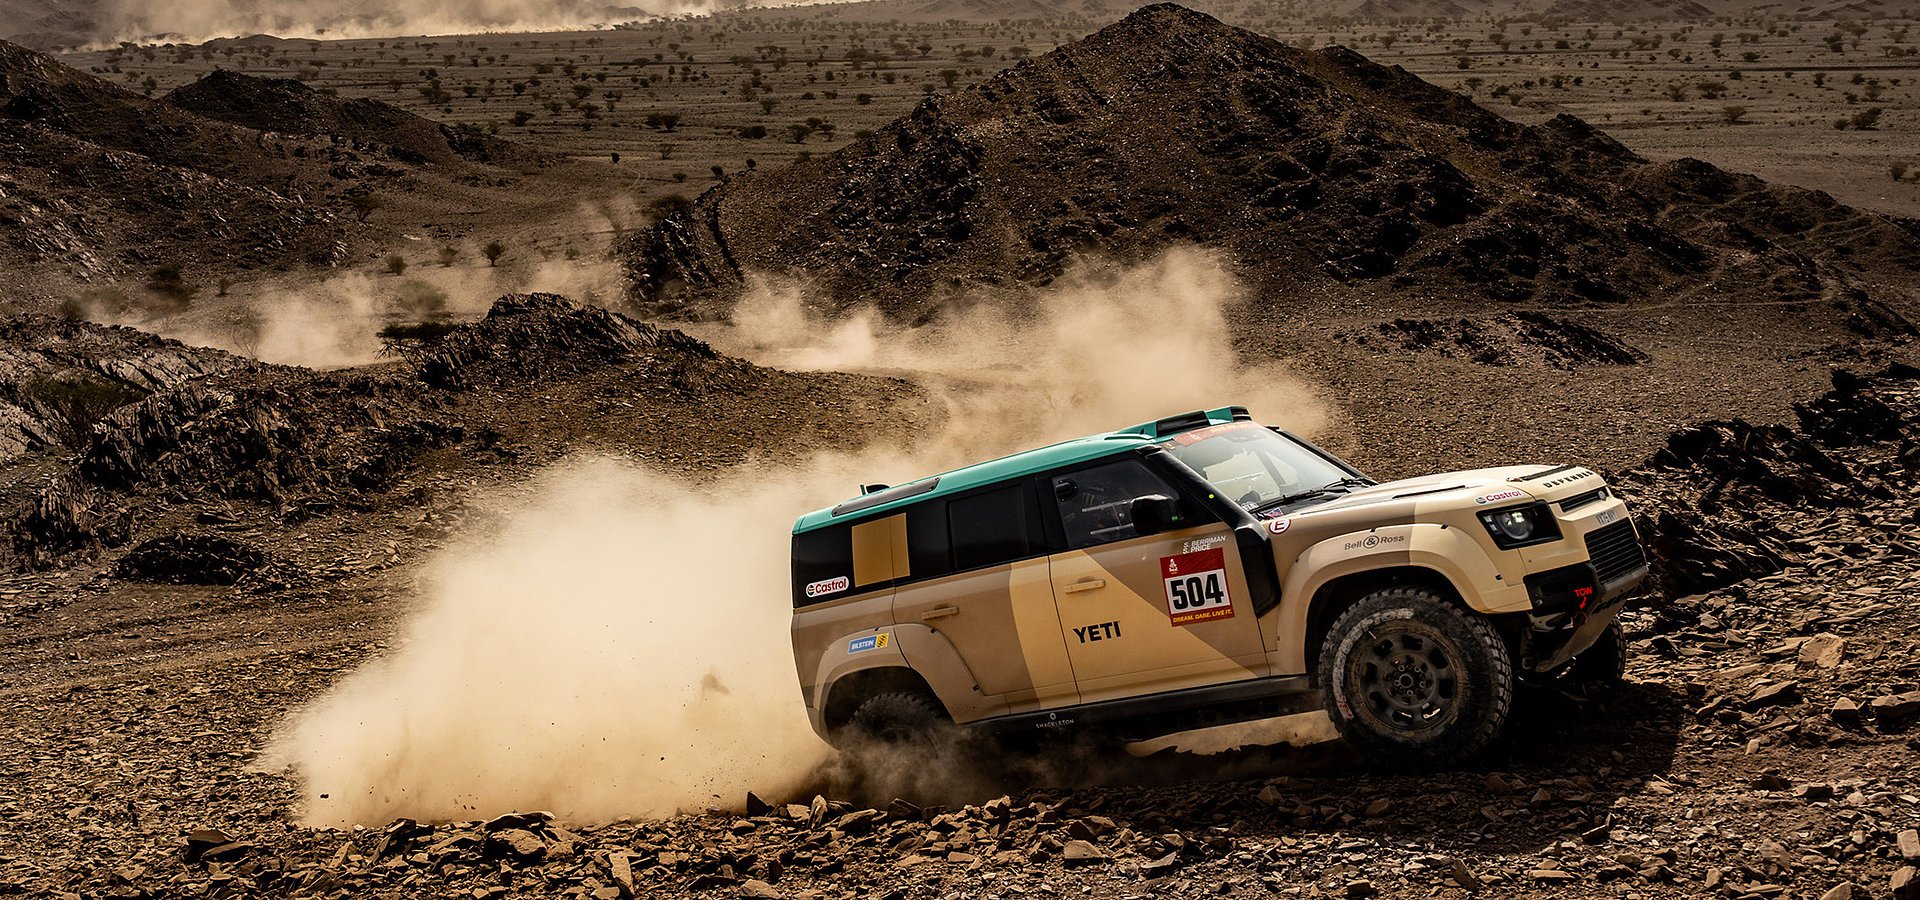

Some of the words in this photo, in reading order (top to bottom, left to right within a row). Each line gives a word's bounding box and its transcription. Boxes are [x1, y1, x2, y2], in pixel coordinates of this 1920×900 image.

[1485, 490, 1521, 501] Castrol
[1275, 521, 1285, 530] E
[1191, 535, 1226, 547] BERRIMAN
[1344, 541, 1362, 550] Bell
[1380, 535, 1405, 544] Ross
[1190, 543, 1212, 553] PRICE
[815, 578, 846, 593] Castrol
[1170, 573, 1224, 610] 504
[1573, 586, 1593, 597] TOW
[1173, 615, 1194, 623] DREAM.
[1195, 612, 1211, 620] DARE.
[1212, 609, 1224, 617] LIVE
[1072, 621, 1122, 644] YETI
[851, 640, 875, 651] BILSTEIN
